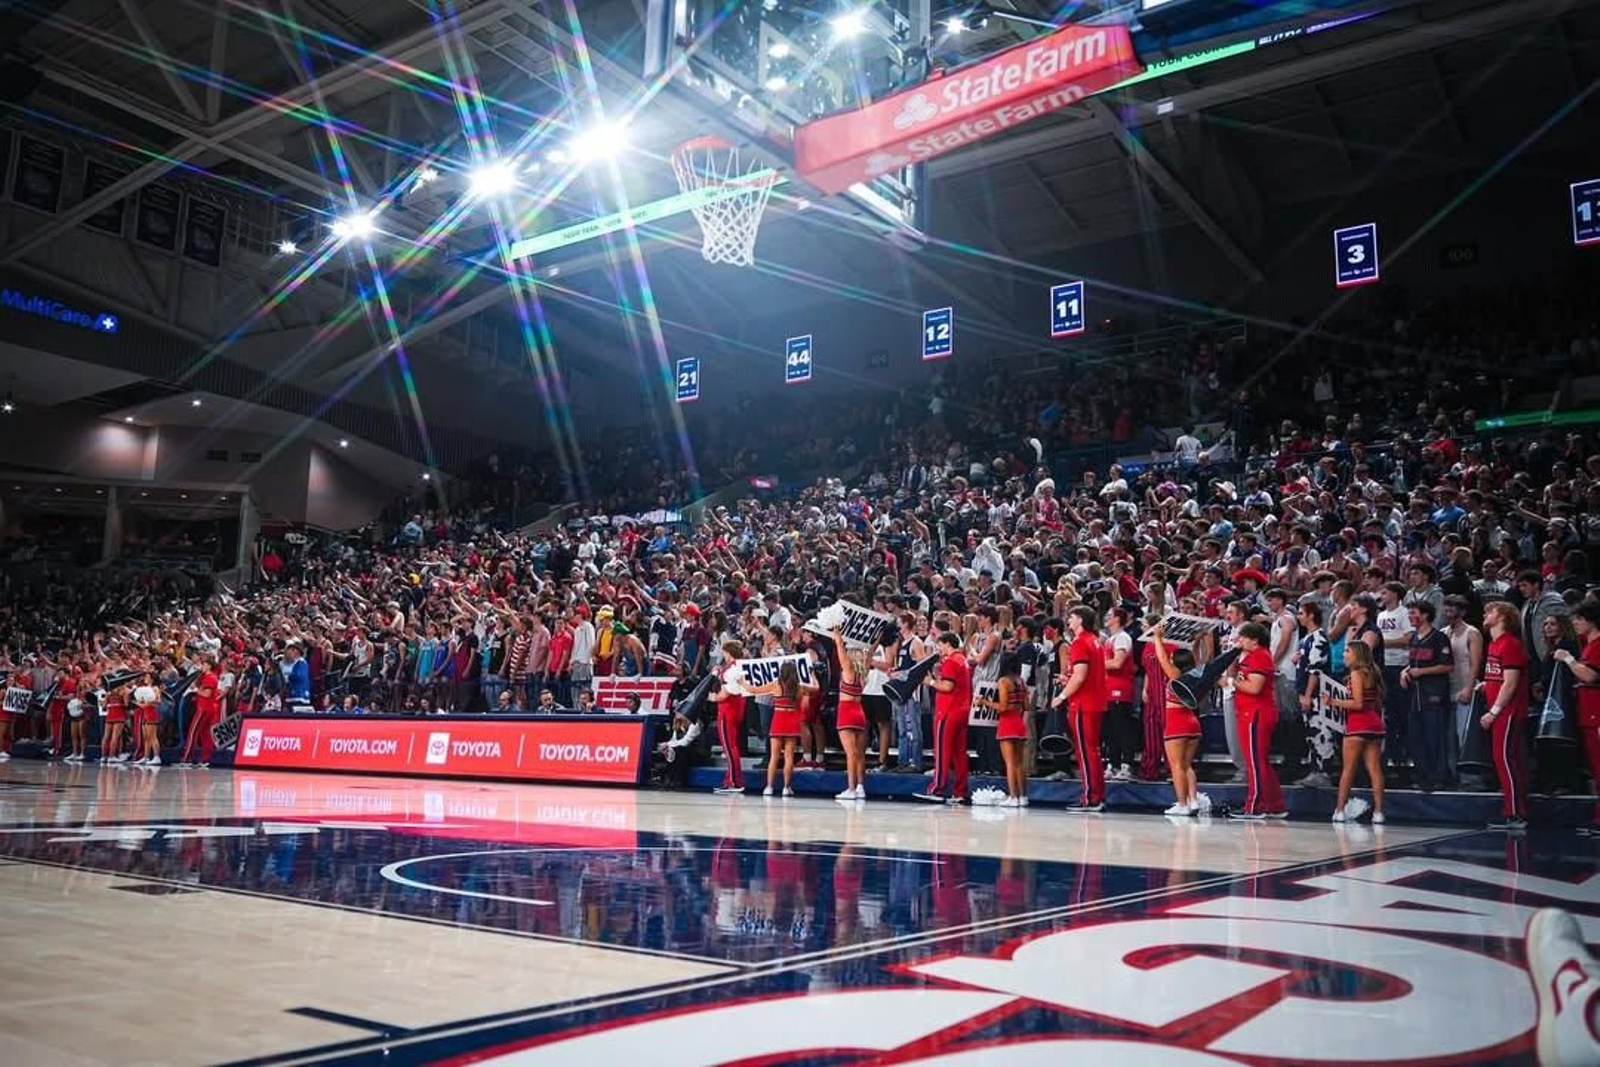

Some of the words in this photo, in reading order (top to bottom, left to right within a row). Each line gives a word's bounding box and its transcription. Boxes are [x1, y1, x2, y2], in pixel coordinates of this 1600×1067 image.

[1347, 244, 1366, 264] 3
[2, 288, 91, 327] MultiCare
[1056, 298, 1079, 318] 11
[926, 323, 949, 342] 12
[788, 350, 810, 367] 44
[679, 371, 697, 387] 21
[1380, 618, 1397, 630] AGS
[6, 690, 30, 711] NOISE
[263, 736, 301, 751] TOYOTA
[330, 739, 397, 755] TOYOTA.COM
[452, 741, 501, 758] TOYOTA
[539, 743, 630, 762] TOYOTA.COM
